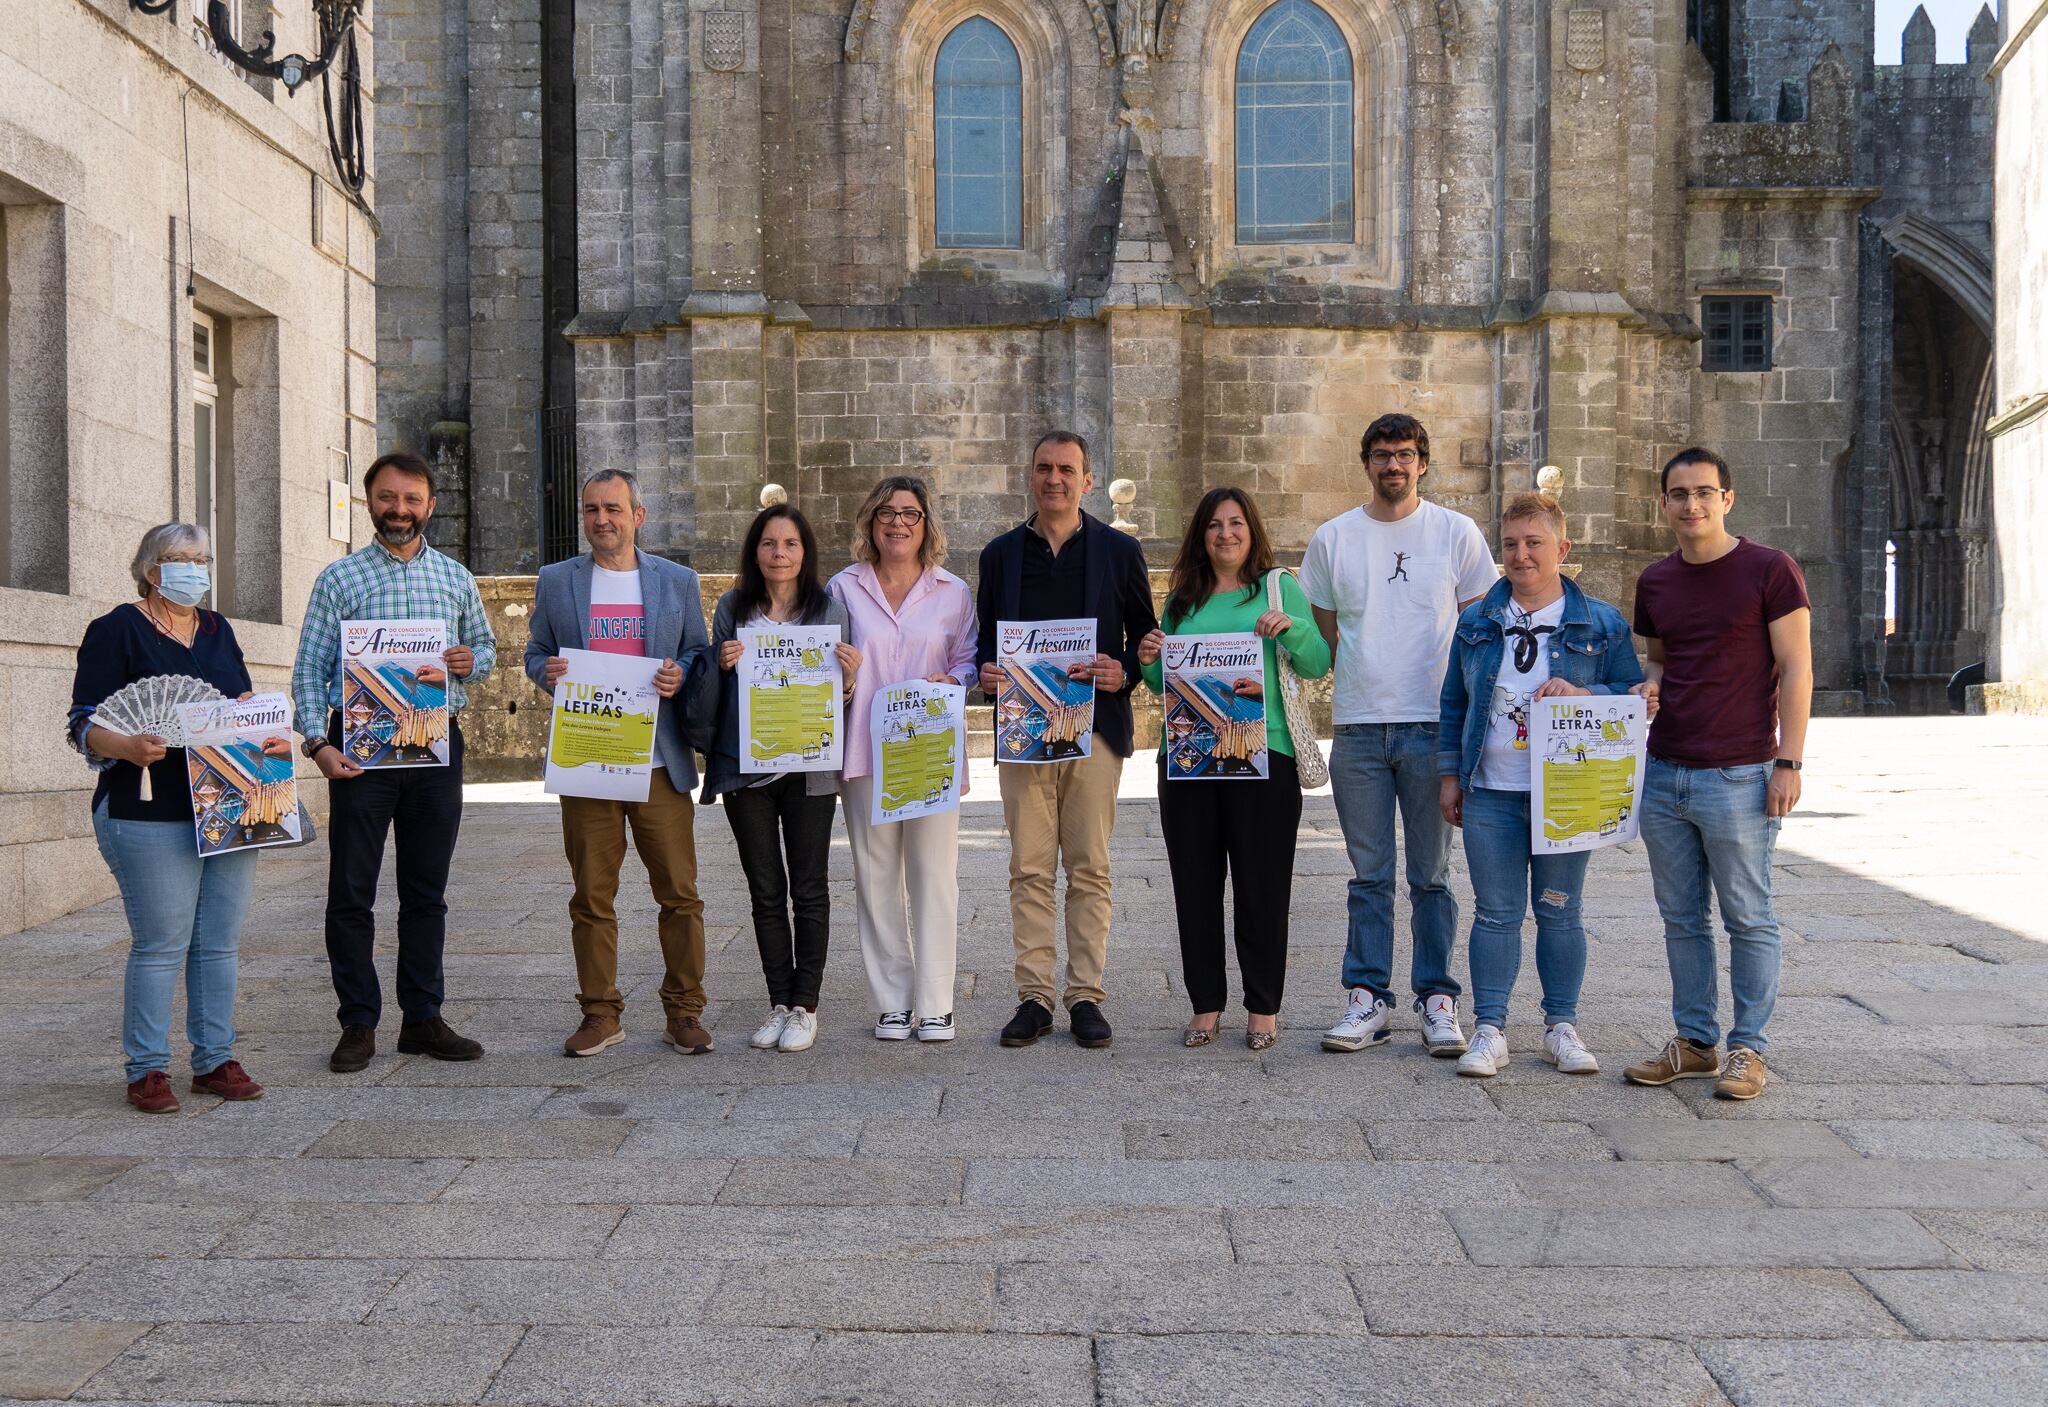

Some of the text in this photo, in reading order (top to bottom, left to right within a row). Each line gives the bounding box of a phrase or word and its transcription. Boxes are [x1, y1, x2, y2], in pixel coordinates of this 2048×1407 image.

[348, 627, 368, 635] XXIV
[589, 617, 646, 639] INGFIE
[1004, 628, 1024, 636] XXIV
[346, 628, 441, 656] Artesanía
[756, 635, 794, 648] TUI en
[1002, 628, 1091, 655] Artesanía
[1166, 642, 1185, 650] XXIV
[758, 648, 802, 658] LETRAS
[1165, 642, 1257, 670] Artesanía
[565, 682, 614, 703] TUI en
[887, 688, 920, 702] TUI en
[564, 700, 623, 718] LETRAS
[887, 698, 927, 713] LETRAS
[1551, 705, 1592, 718] TUI en
[1552, 719, 1602, 730] LETRAS
